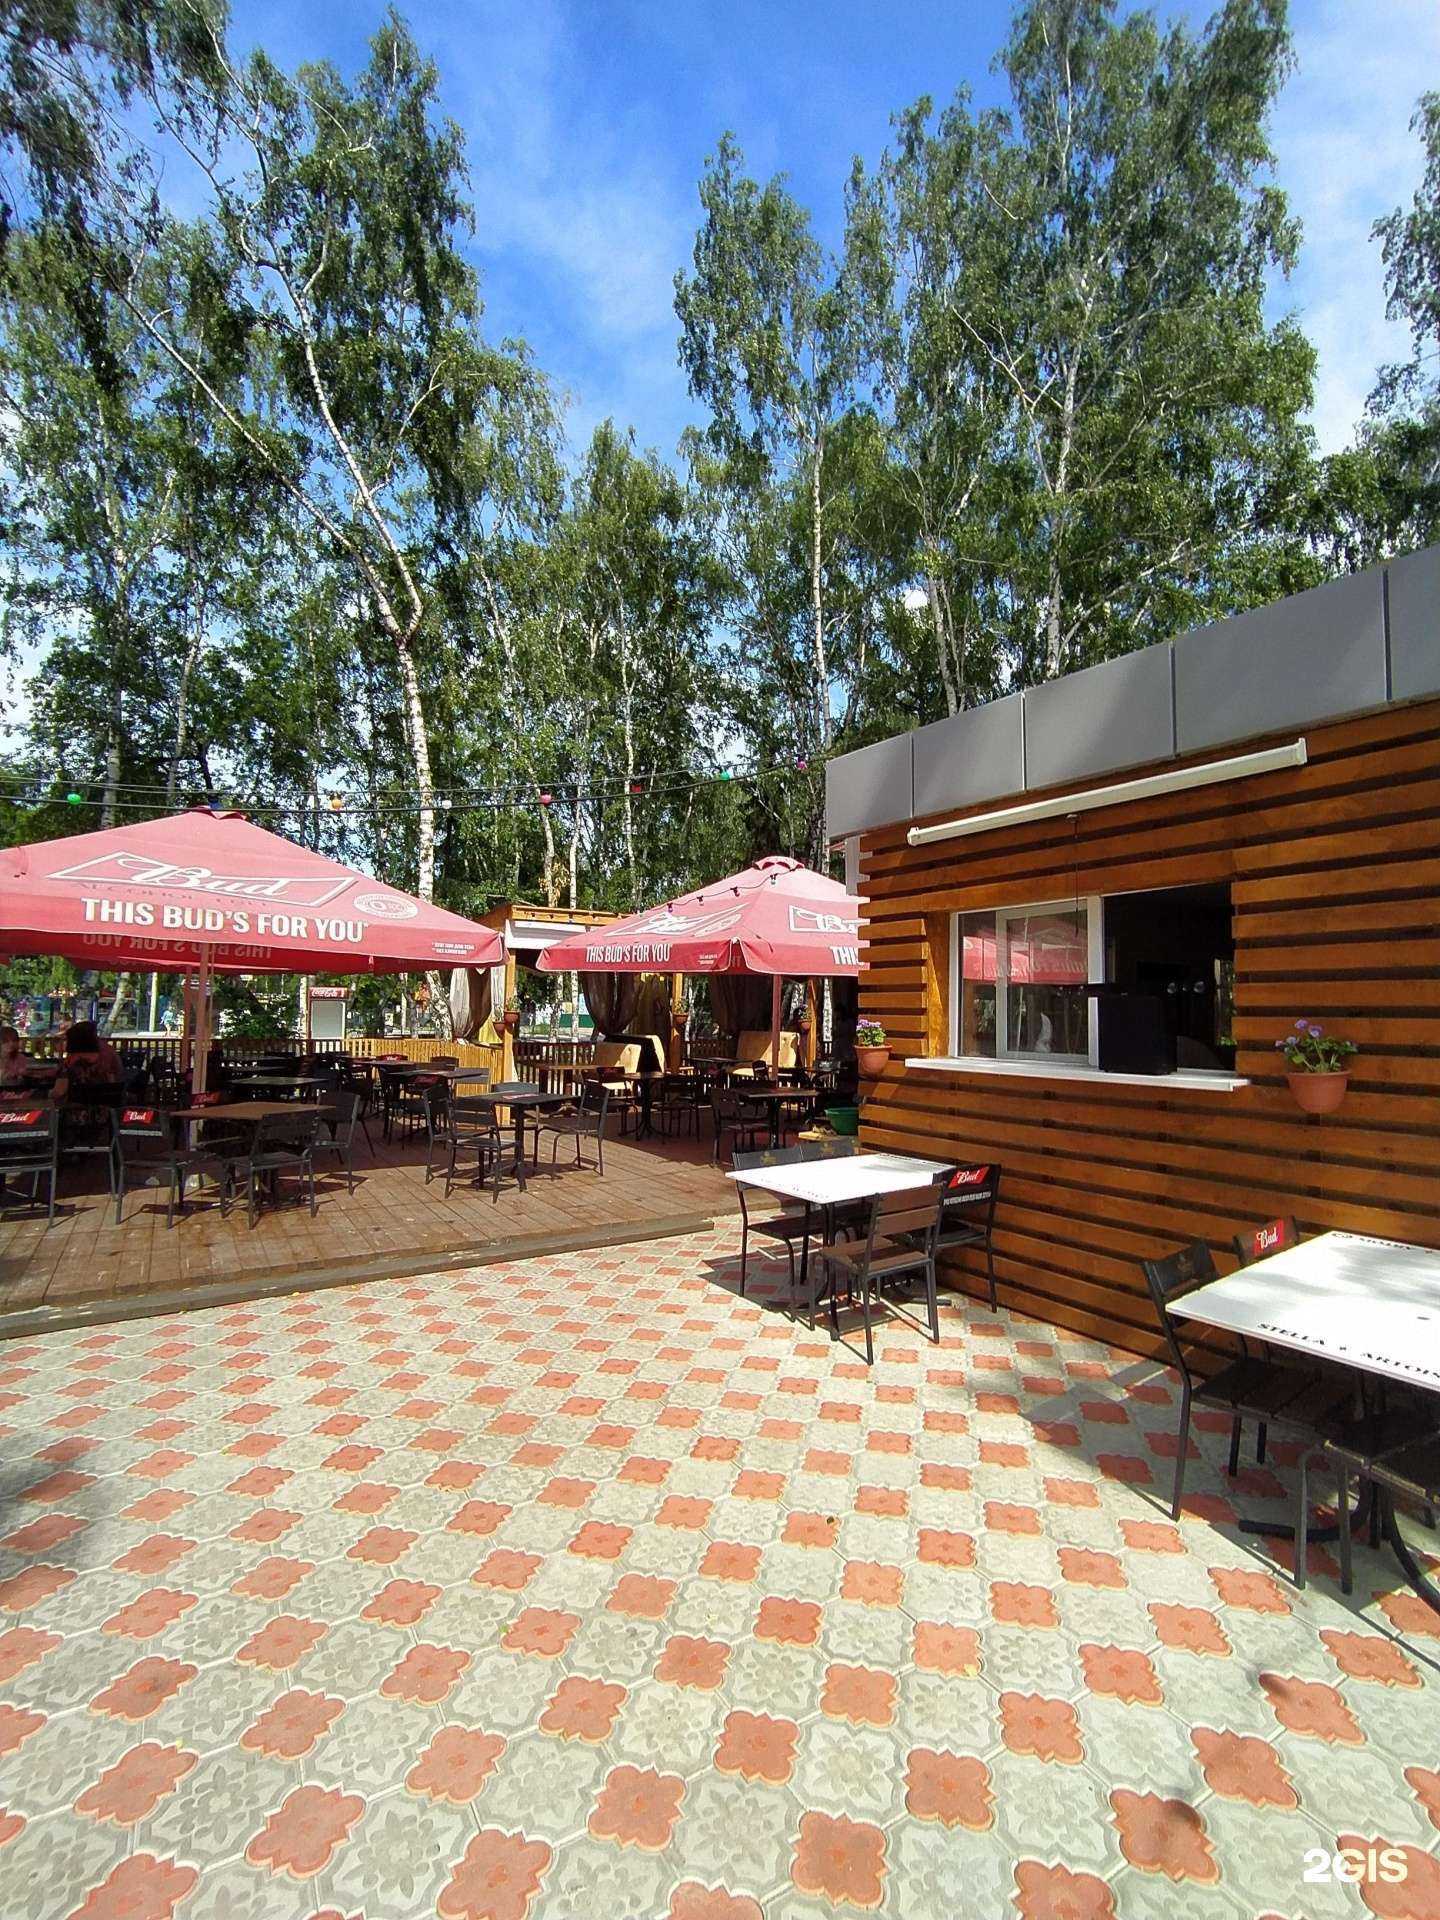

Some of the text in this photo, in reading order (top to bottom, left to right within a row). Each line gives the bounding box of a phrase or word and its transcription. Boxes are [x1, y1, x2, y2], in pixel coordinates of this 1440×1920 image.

[117, 858, 290, 896] Bud
[81, 898, 366, 943] THIS BUD'S FOR YOU
[586, 943, 672, 964] THIS BUD'S FOR YOU
[0, 1112, 30, 1123] Bud
[127, 1110, 146, 1121] Bud
[956, 1169, 980, 1184] Bud
[1256, 1227, 1278, 1249] Bud
[1257, 1322, 1325, 1346] STELLA
